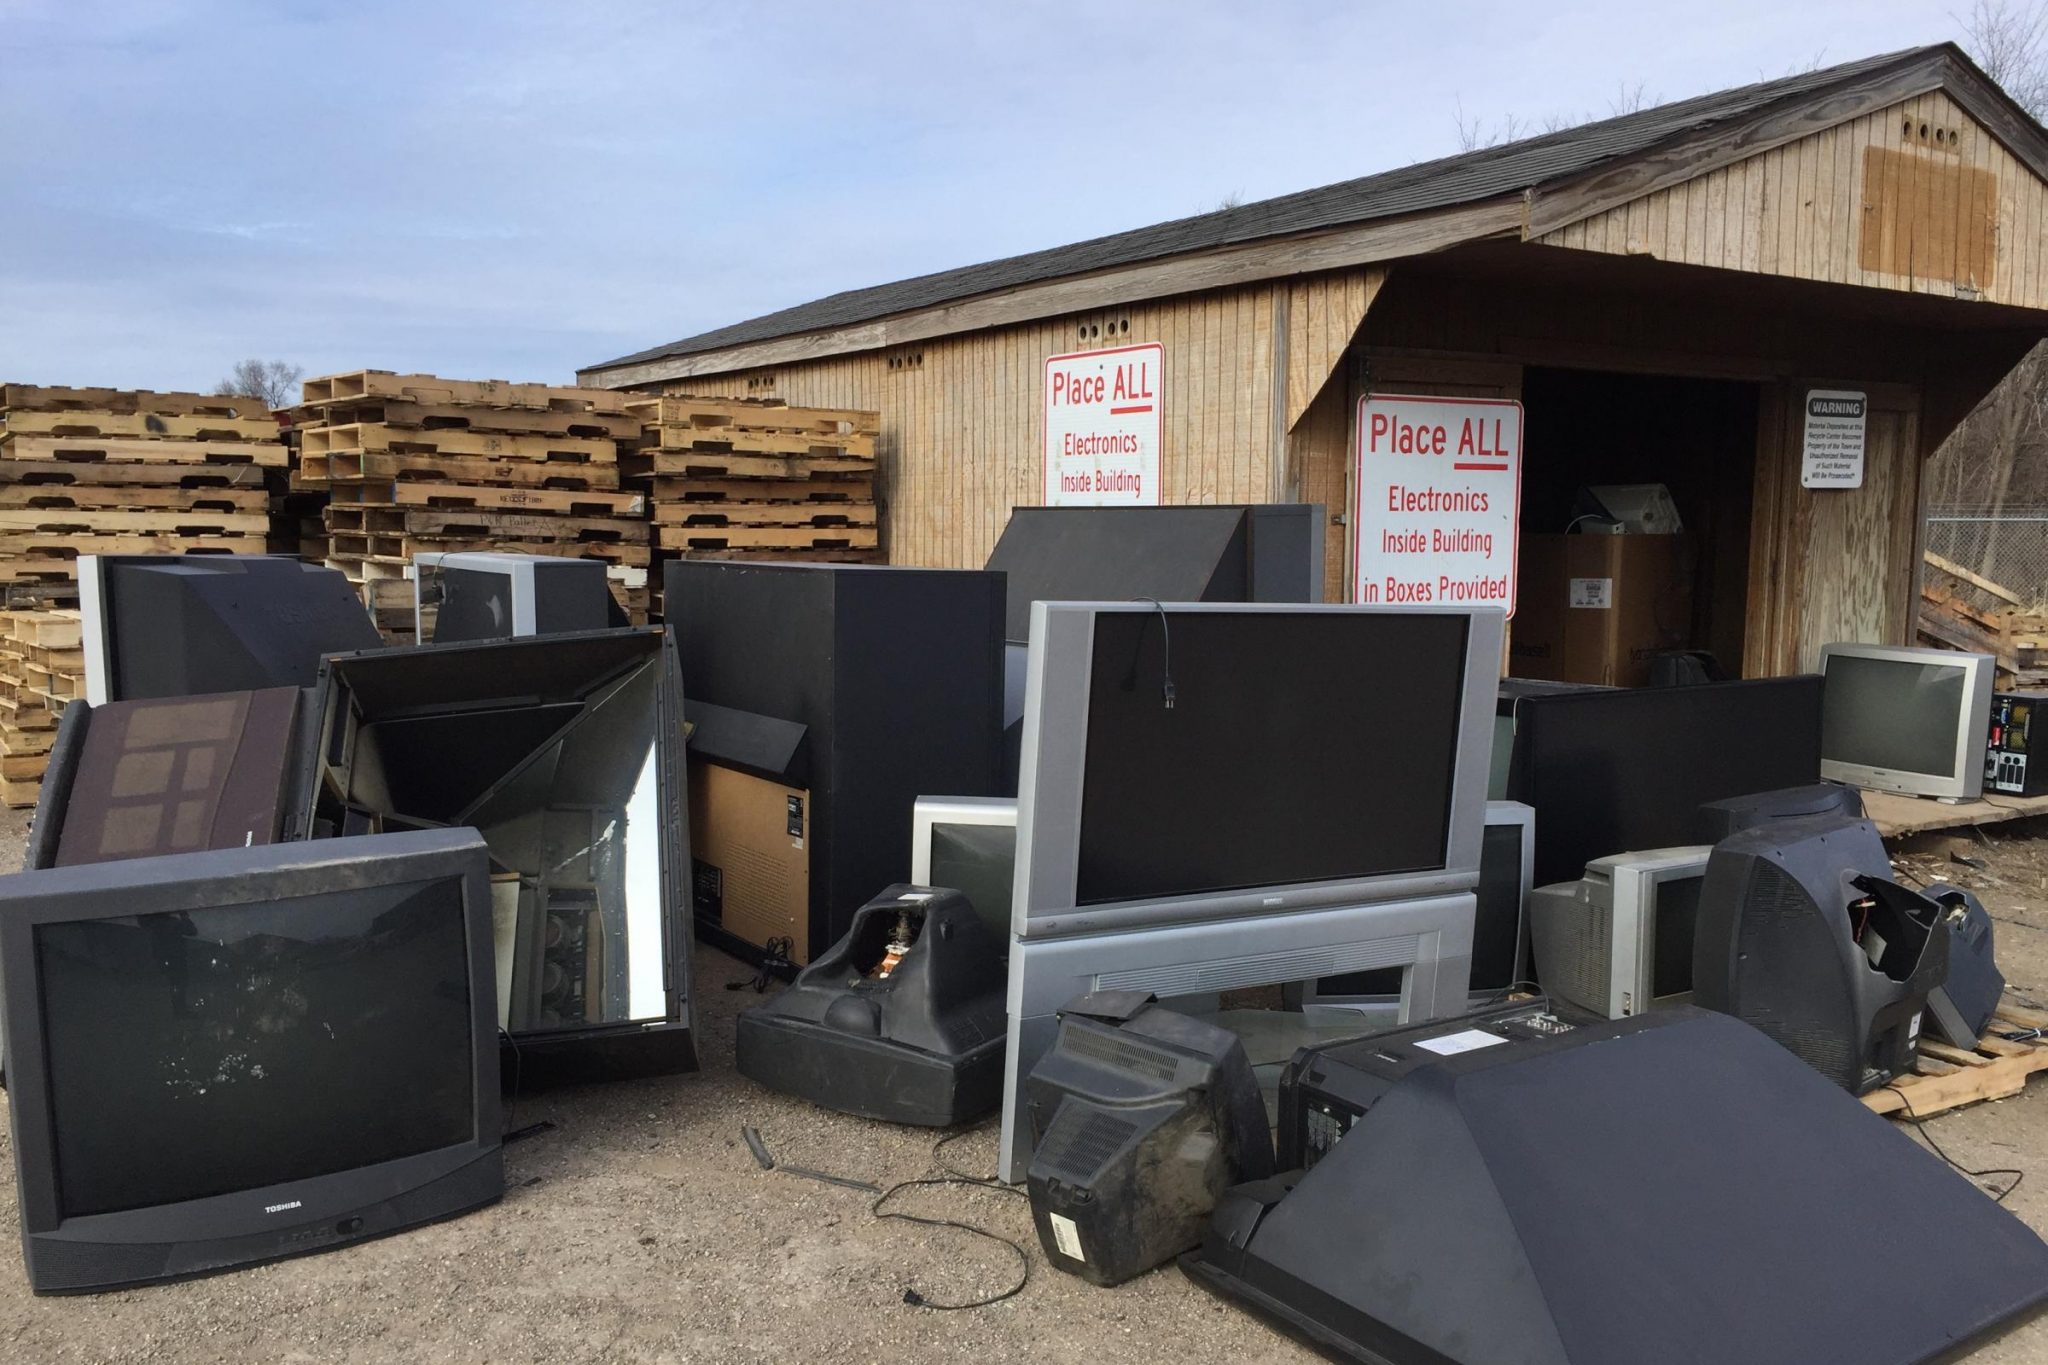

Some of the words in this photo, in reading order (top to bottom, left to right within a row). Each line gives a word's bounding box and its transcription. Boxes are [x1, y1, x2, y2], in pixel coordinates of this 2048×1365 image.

[1053, 371, 1105, 406] Place
[1113, 362, 1153, 401] ALL
[1812, 401, 1860, 415] WARNING
[1064, 429, 1138, 456] Electronics
[1370, 413, 1447, 455] Place
[1457, 417, 1509, 456] ALL
[1061, 469, 1092, 493] Inside
[1095, 469, 1141, 499] Building
[1388, 485, 1489, 512] Electronics
[1382, 528, 1427, 554] Inside
[1433, 528, 1492, 559] Building
[1364, 577, 1379, 603] in
[1386, 576, 1432, 603] Boxes
[1439, 575, 1507, 601] Provided
[264, 1200, 302, 1214] TOSHIBA
